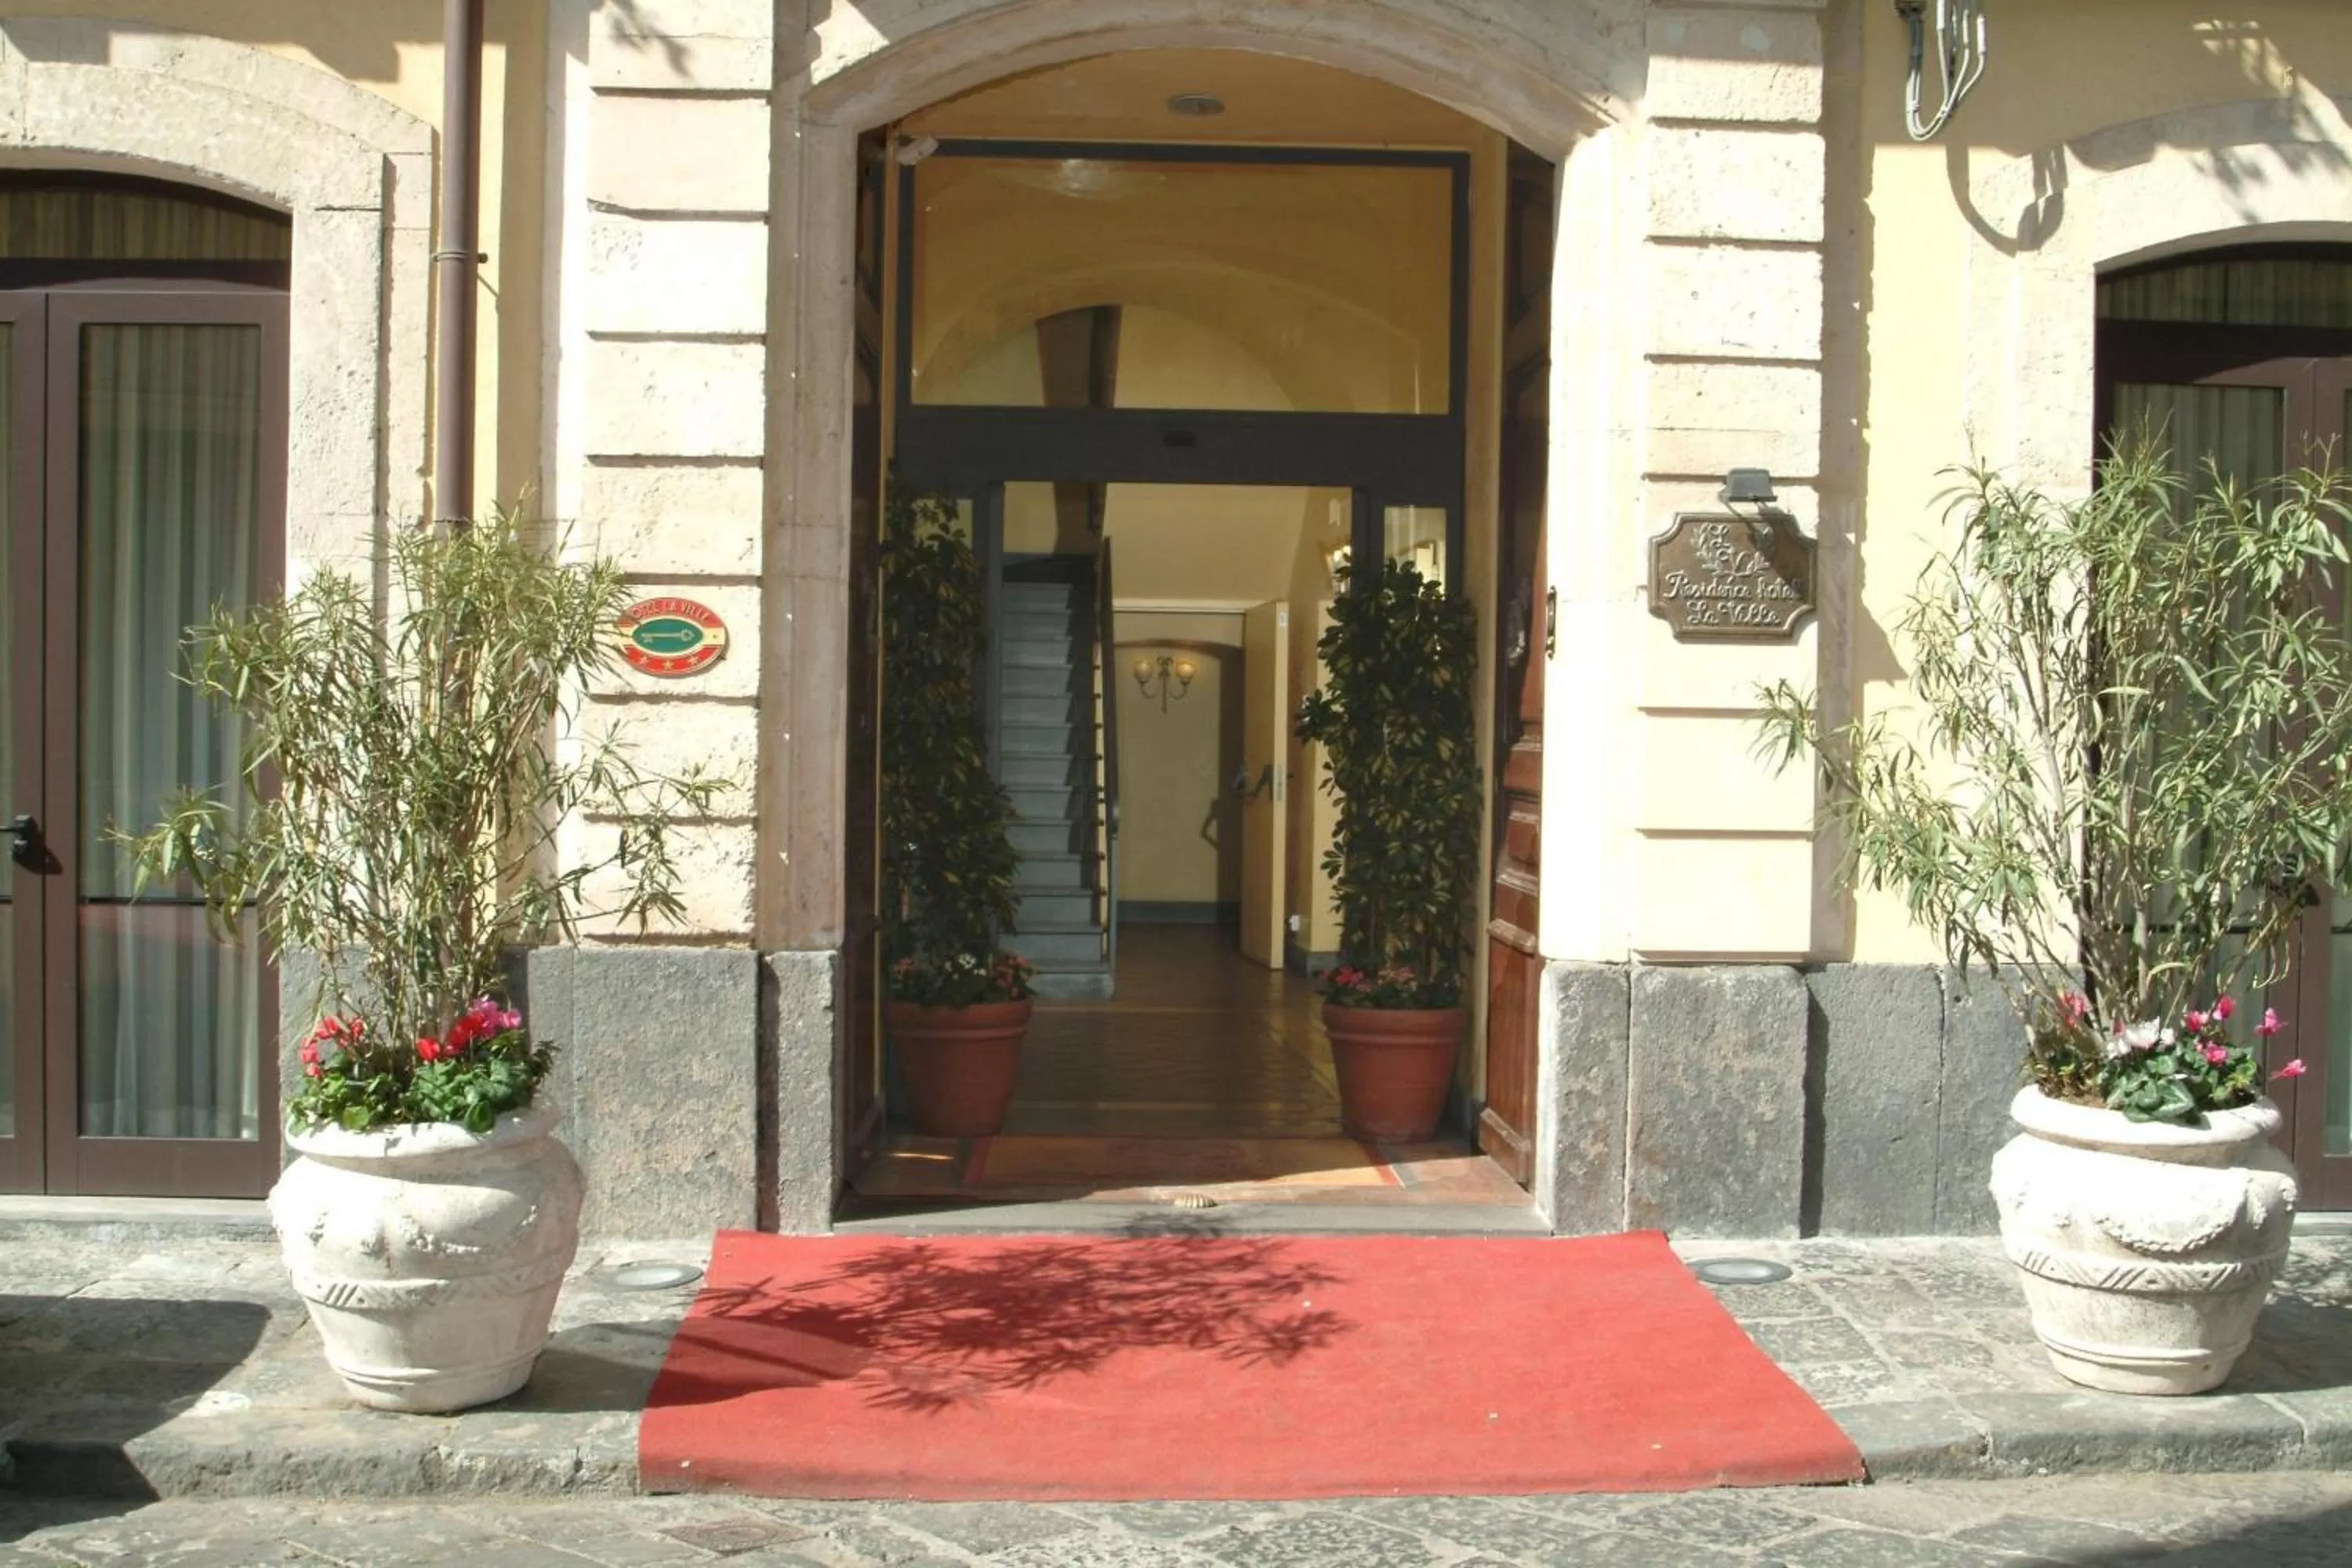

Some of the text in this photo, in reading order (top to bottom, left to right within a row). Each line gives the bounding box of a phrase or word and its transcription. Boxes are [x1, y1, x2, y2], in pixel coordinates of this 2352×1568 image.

[662, 600, 677, 612] LA
[681, 601, 711, 620] VILLE
[1686, 600, 1781, 624] La Ville
